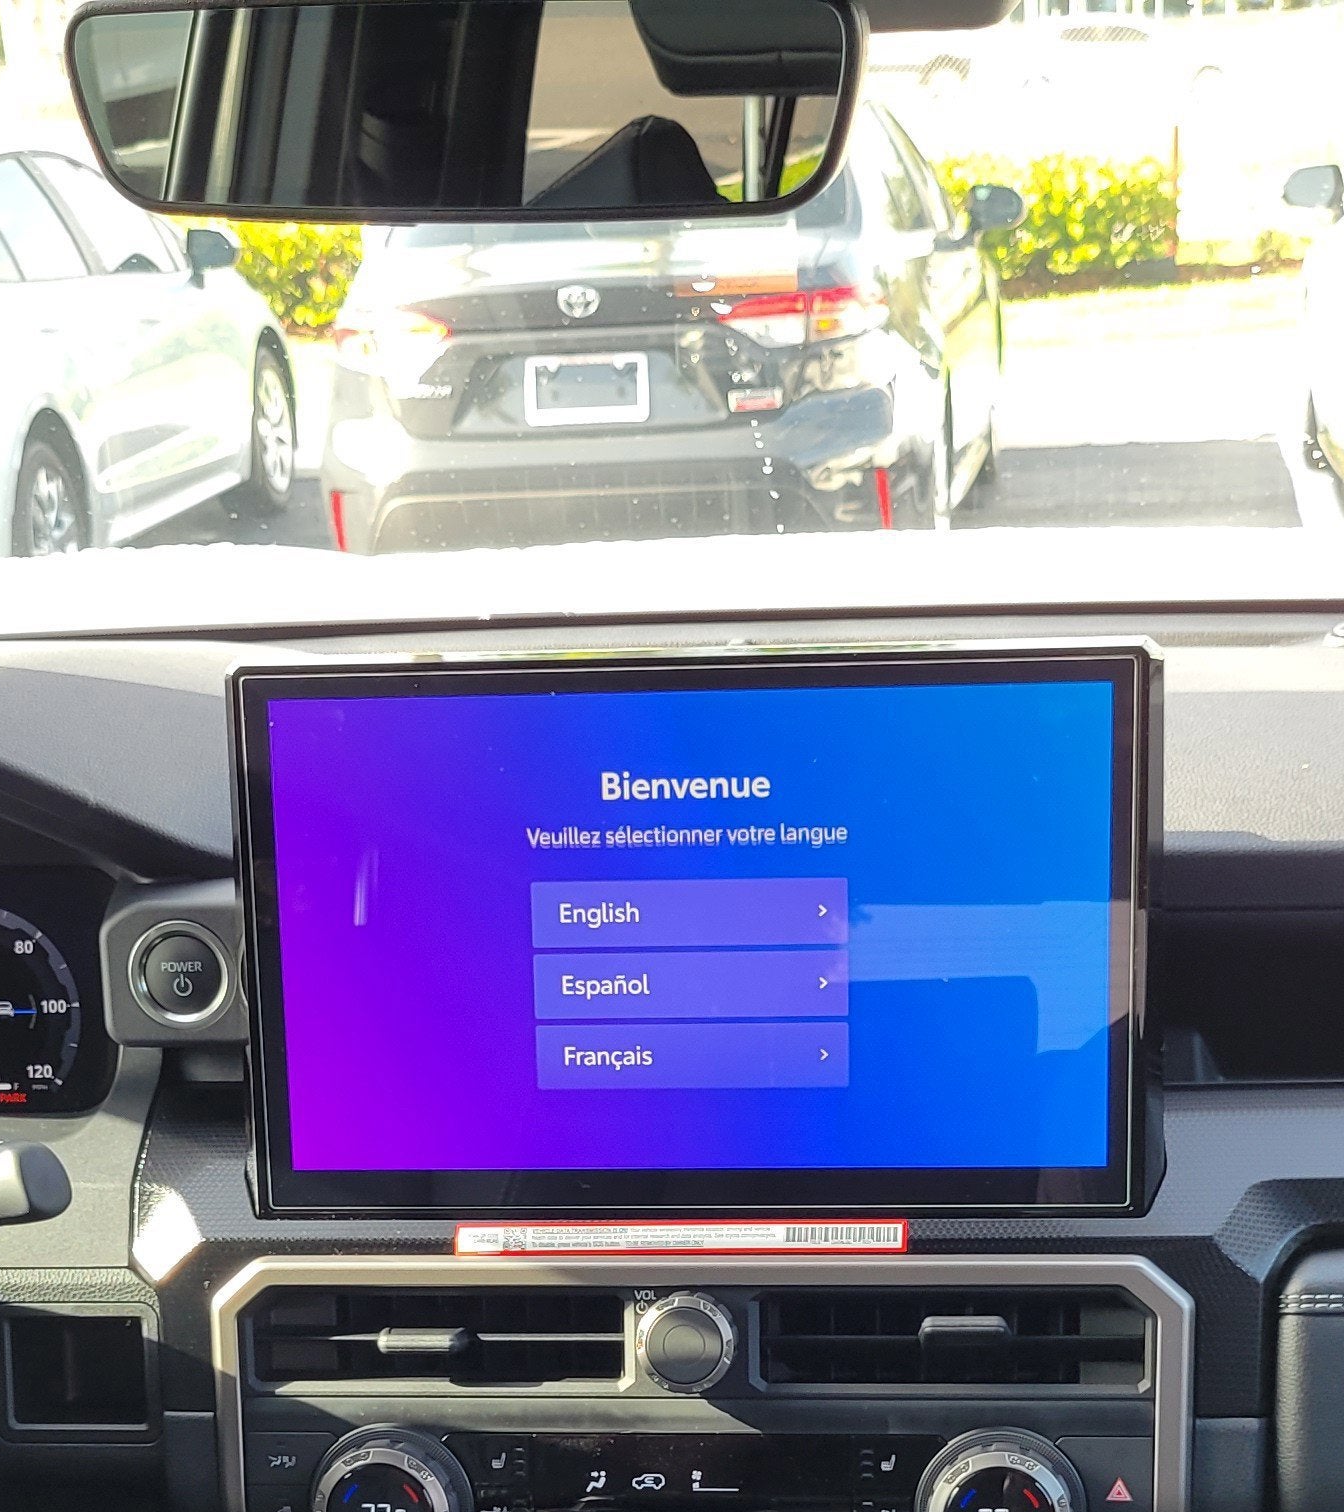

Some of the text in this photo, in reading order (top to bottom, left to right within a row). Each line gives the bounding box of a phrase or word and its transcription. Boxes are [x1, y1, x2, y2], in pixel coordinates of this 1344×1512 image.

[600, 771, 771, 801] Bienvenue
[526, 822, 849, 848] Veuillez sélectionner votre langue
[558, 902, 641, 928] English
[13, 939, 35, 954] 80
[160, 961, 203, 973] POWER
[561, 973, 651, 1001] Español
[40, 999, 67, 1014] 100
[563, 1044, 654, 1072] Français
[26, 1064, 54, 1080] 120
[0, 1092, 28, 1104] PARK
